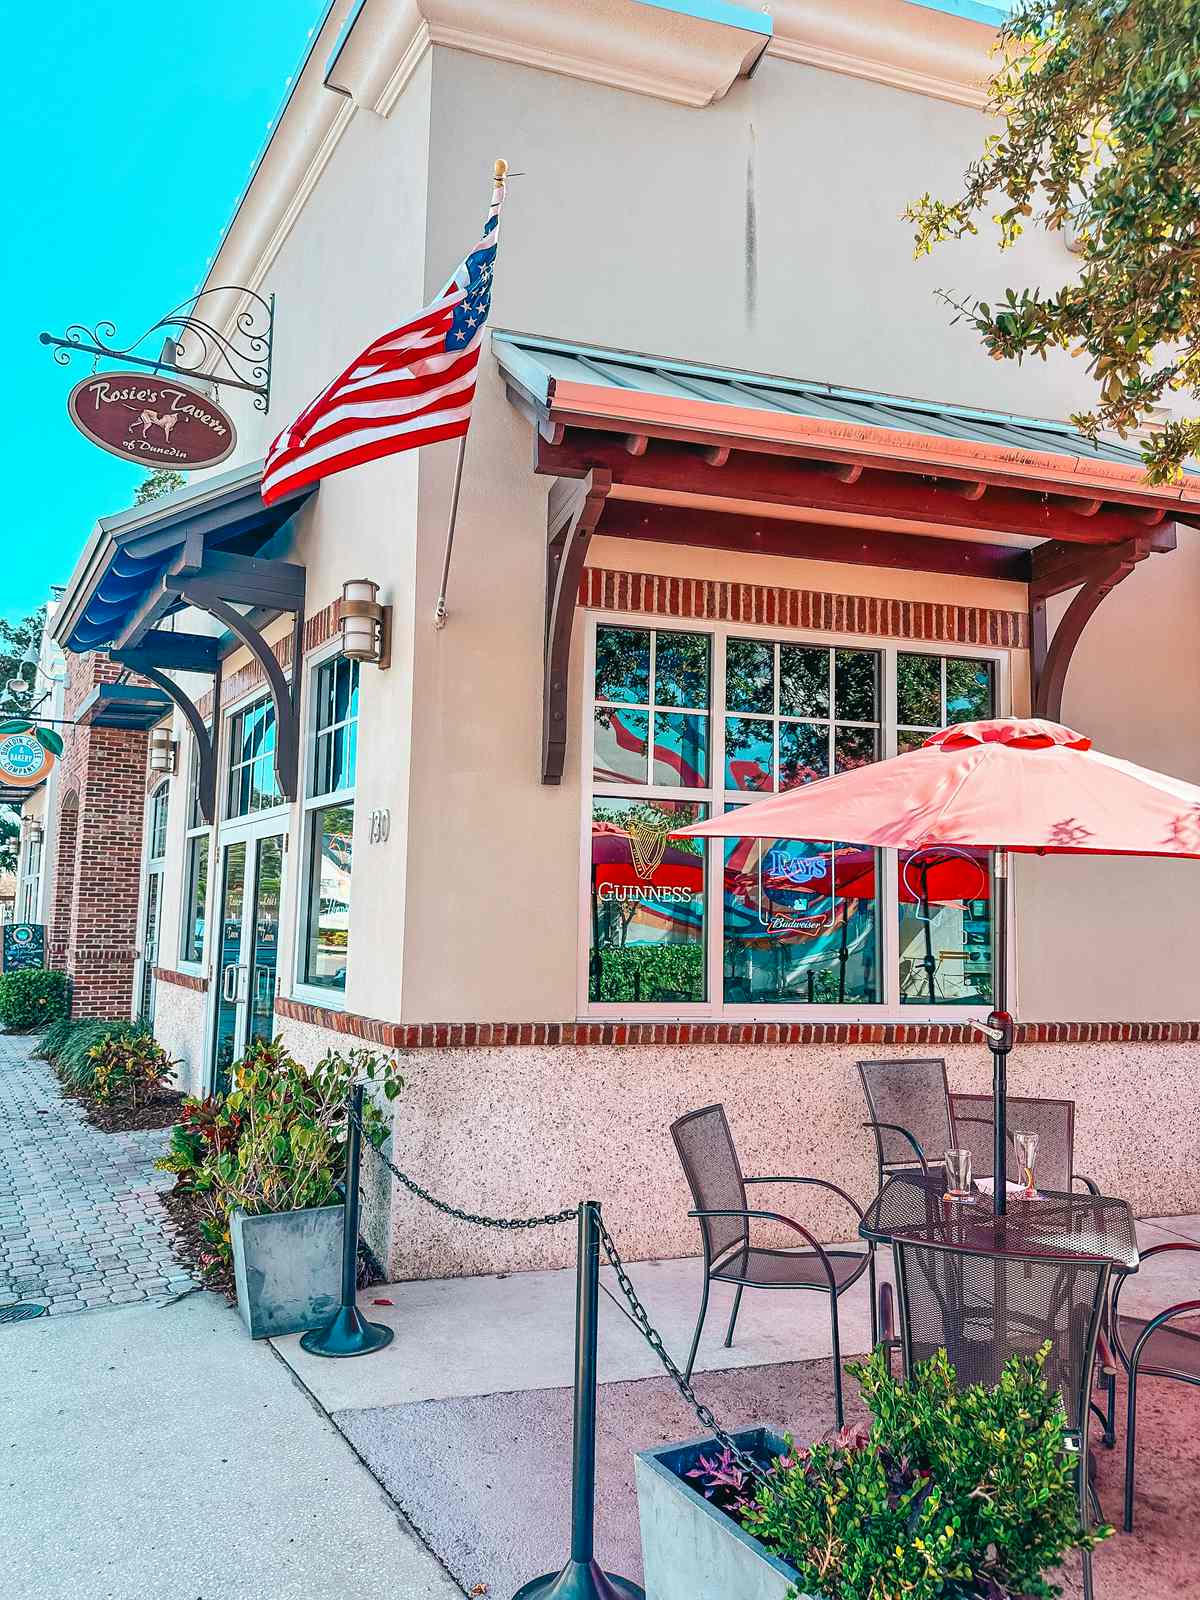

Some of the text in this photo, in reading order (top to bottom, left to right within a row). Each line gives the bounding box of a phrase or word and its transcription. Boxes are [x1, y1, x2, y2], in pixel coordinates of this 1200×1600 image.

[89, 382, 226, 436] Rosie's Tavern
[123, 440, 187, 459] of Dunedin
[4, 762, 36, 774] COMPANY
[369, 808, 391, 845] 130
[598, 881, 692, 903] GUINNESS
[770, 917, 821, 929] Budweiser
